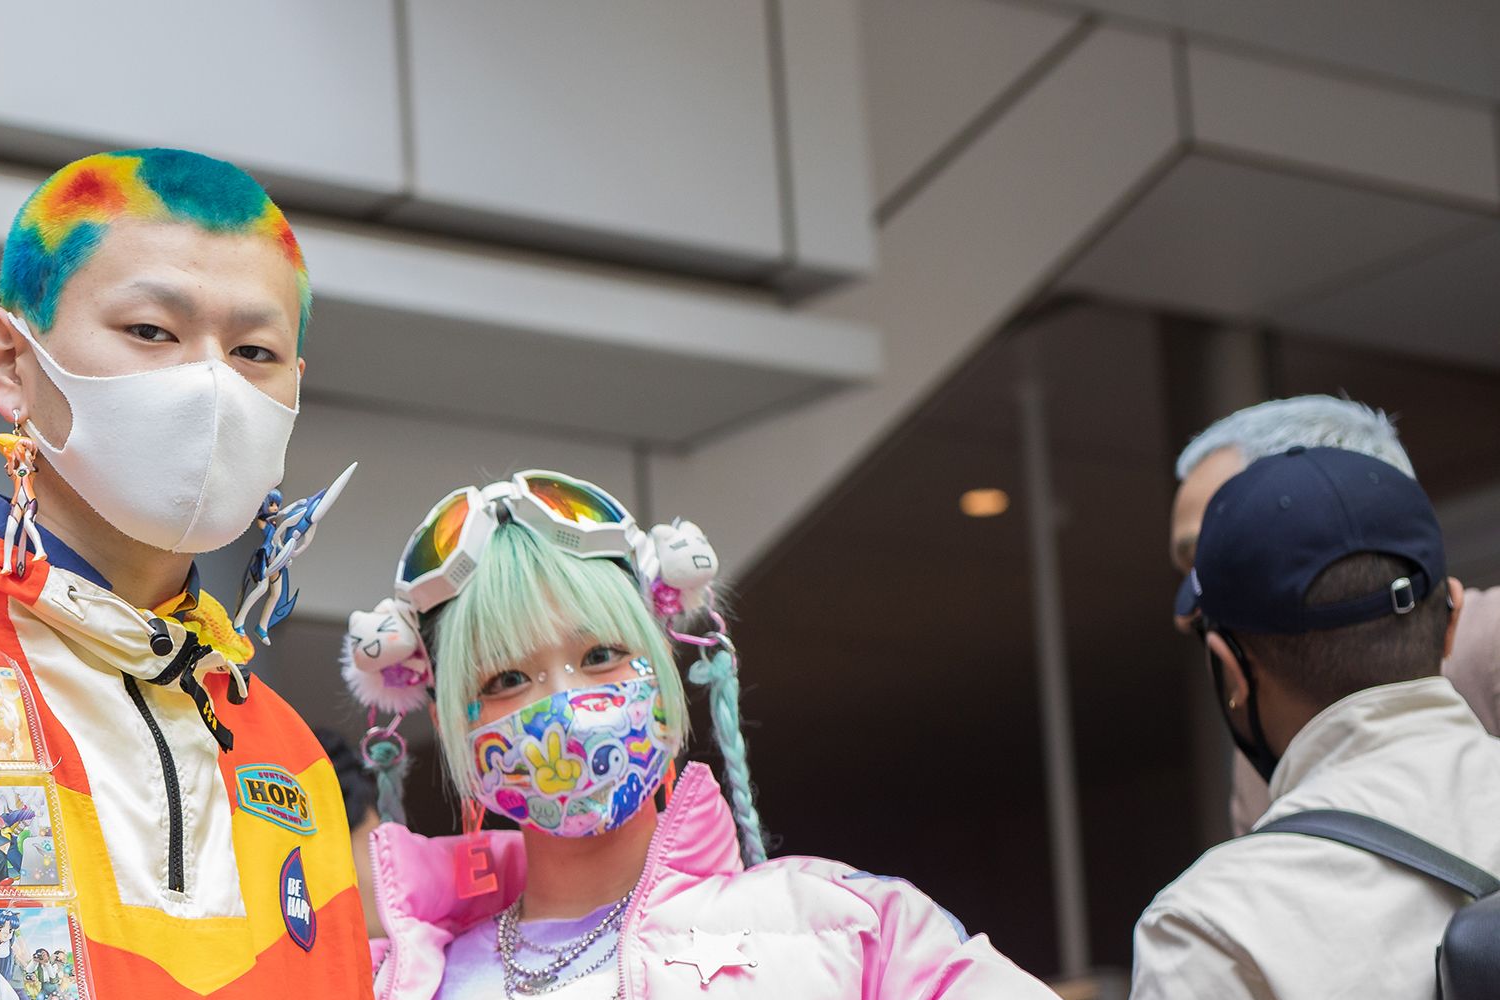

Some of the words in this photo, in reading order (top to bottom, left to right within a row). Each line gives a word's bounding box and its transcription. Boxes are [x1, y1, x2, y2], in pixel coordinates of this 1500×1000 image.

[245, 779, 308, 819] HOP'S
[287, 877, 302, 897] BE
[455, 836, 498, 899] E
